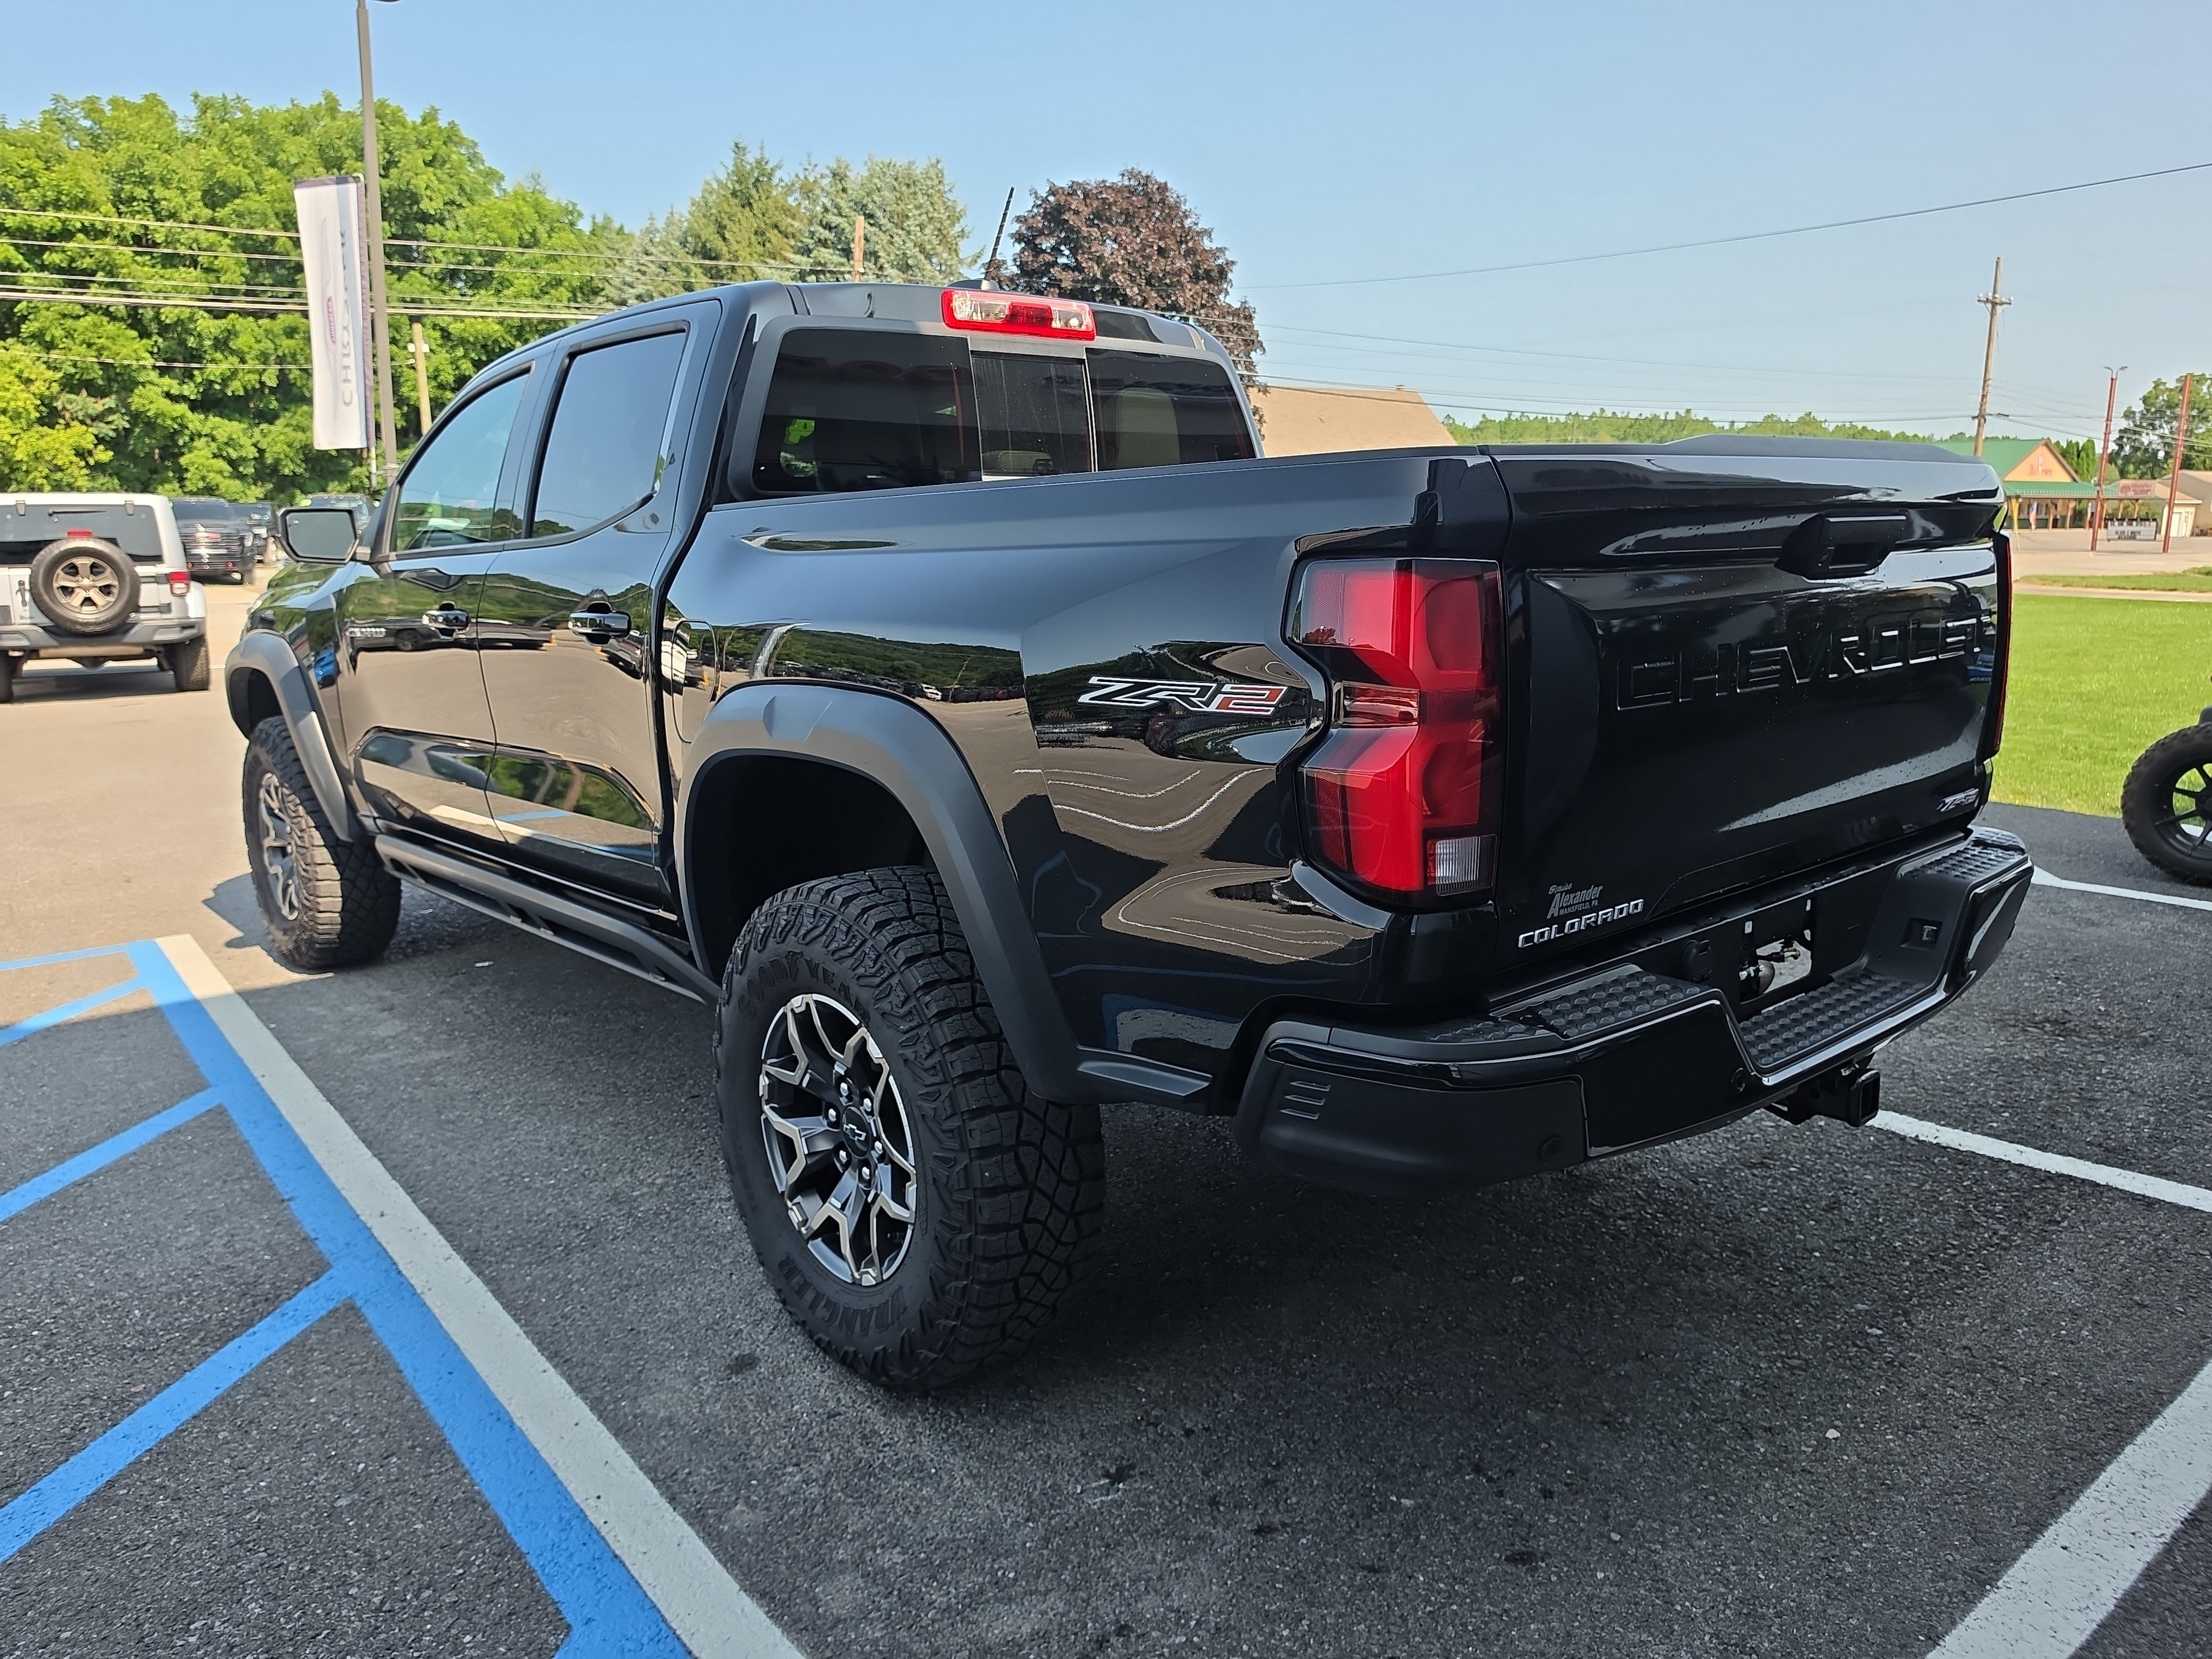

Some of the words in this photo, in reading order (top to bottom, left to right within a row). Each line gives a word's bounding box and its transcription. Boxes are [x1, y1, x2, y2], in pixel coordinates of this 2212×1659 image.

[1616, 615, 1991, 711] CHEVROLET
[1077, 676, 1289, 717] ZR2
[1518, 899, 1644, 948] COLORADO
[1546, 884, 1603, 919] Alexander
[1559, 903, 1590, 916] MANSFIELD,
[778, 1252, 908, 1336] WRANGLER
